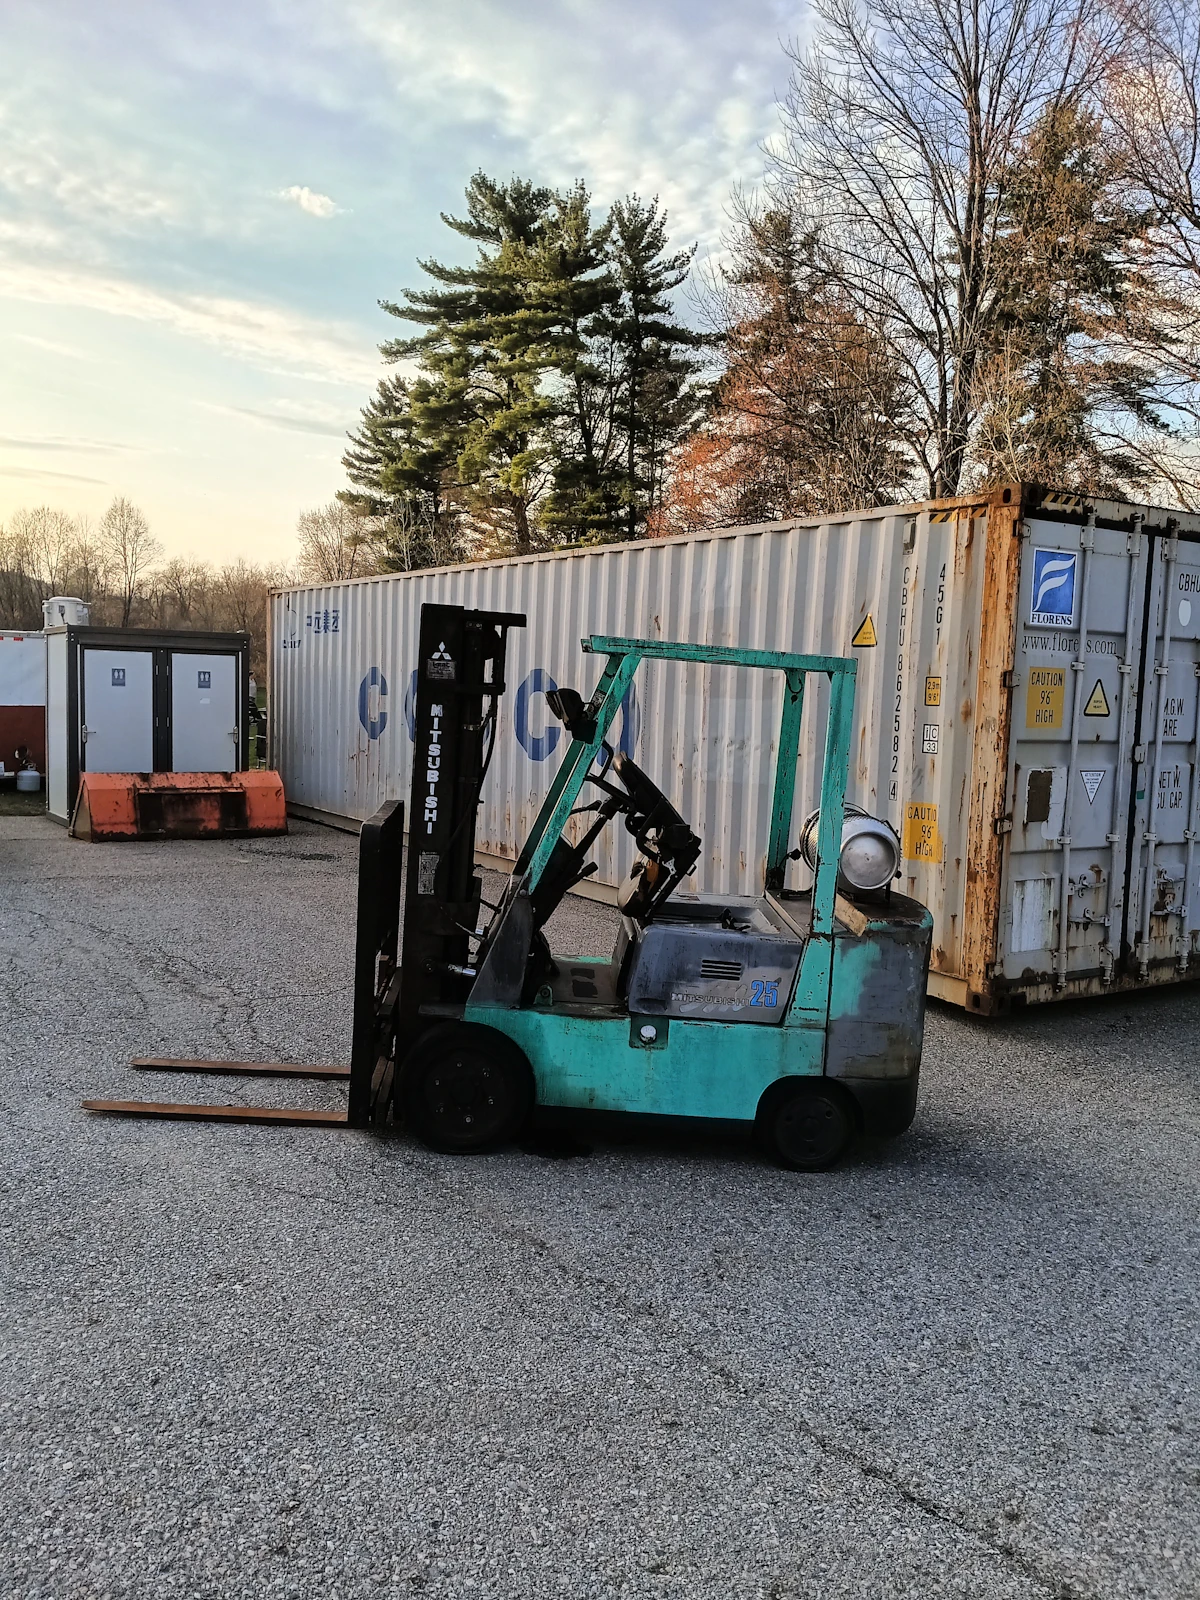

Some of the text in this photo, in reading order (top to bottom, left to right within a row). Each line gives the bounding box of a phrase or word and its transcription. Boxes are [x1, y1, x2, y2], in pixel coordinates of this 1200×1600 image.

[936, 563, 946, 645] 45G1
[1031, 613, 1073, 626] FLORENS
[1021, 632, 1118, 655] www.flores.com
[1031, 672, 1063, 687] CAUTION
[1035, 709, 1054, 723] HIGH
[1162, 718, 1178, 737] ARE
[926, 742, 936, 752] 33
[424, 704, 444, 834] MITSUBISHI
[1169, 791, 1183, 809] CAP.
[915, 842, 933, 857] HIGH
[750, 980, 779, 1007] 25
